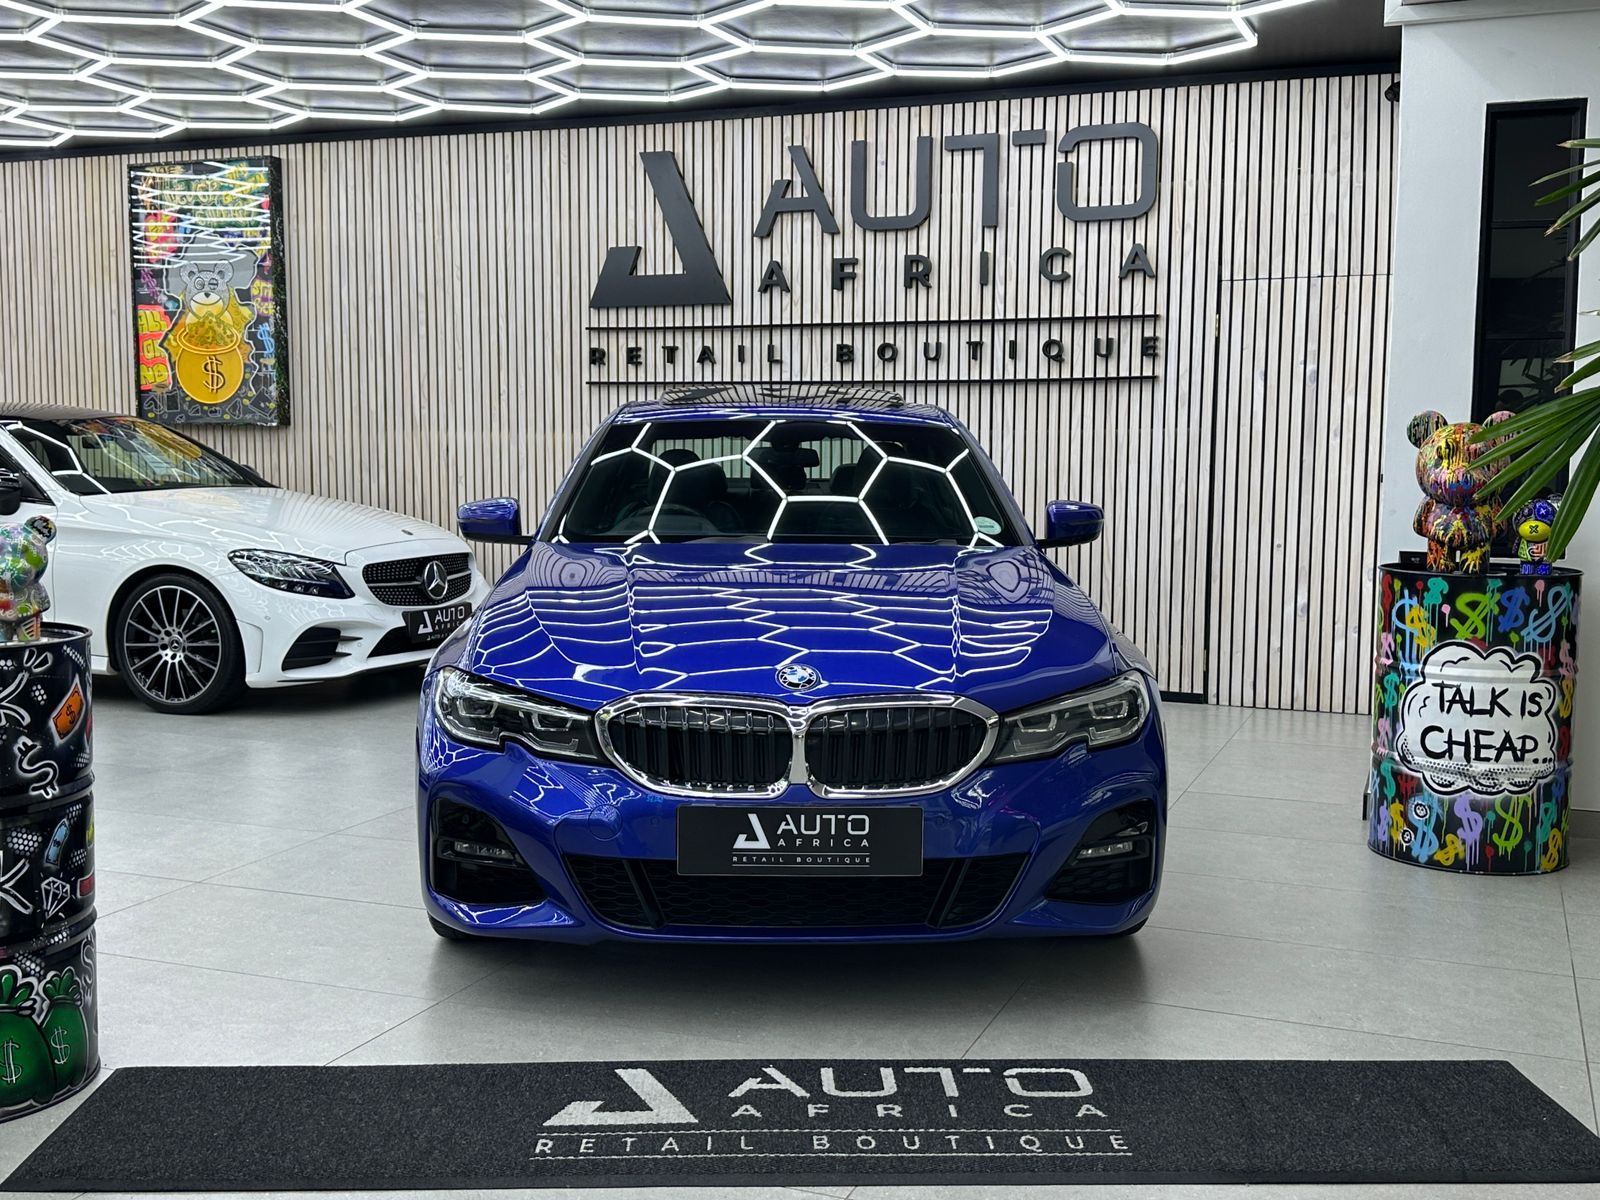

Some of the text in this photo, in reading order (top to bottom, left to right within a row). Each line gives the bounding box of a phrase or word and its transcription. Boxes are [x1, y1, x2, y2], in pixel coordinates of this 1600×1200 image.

[753, 121, 1158, 238] AUTO
[757, 242, 1157, 294] AFRICA
[589, 335, 1160, 367] RETAIL BOUTIQUE
[434, 606, 465, 624] AUTO
[1431, 680, 1544, 719] TALK IS
[776, 814, 871, 835] AUTO
[777, 838, 870, 848] AFRICA
[796, 856, 871, 864] BOUTIQUE
[727, 1065, 1094, 1098] AUTO
[731, 1103, 1108, 1118] AFRICA
[534, 1134, 1130, 1154] RETAIL BOUTIQUE
